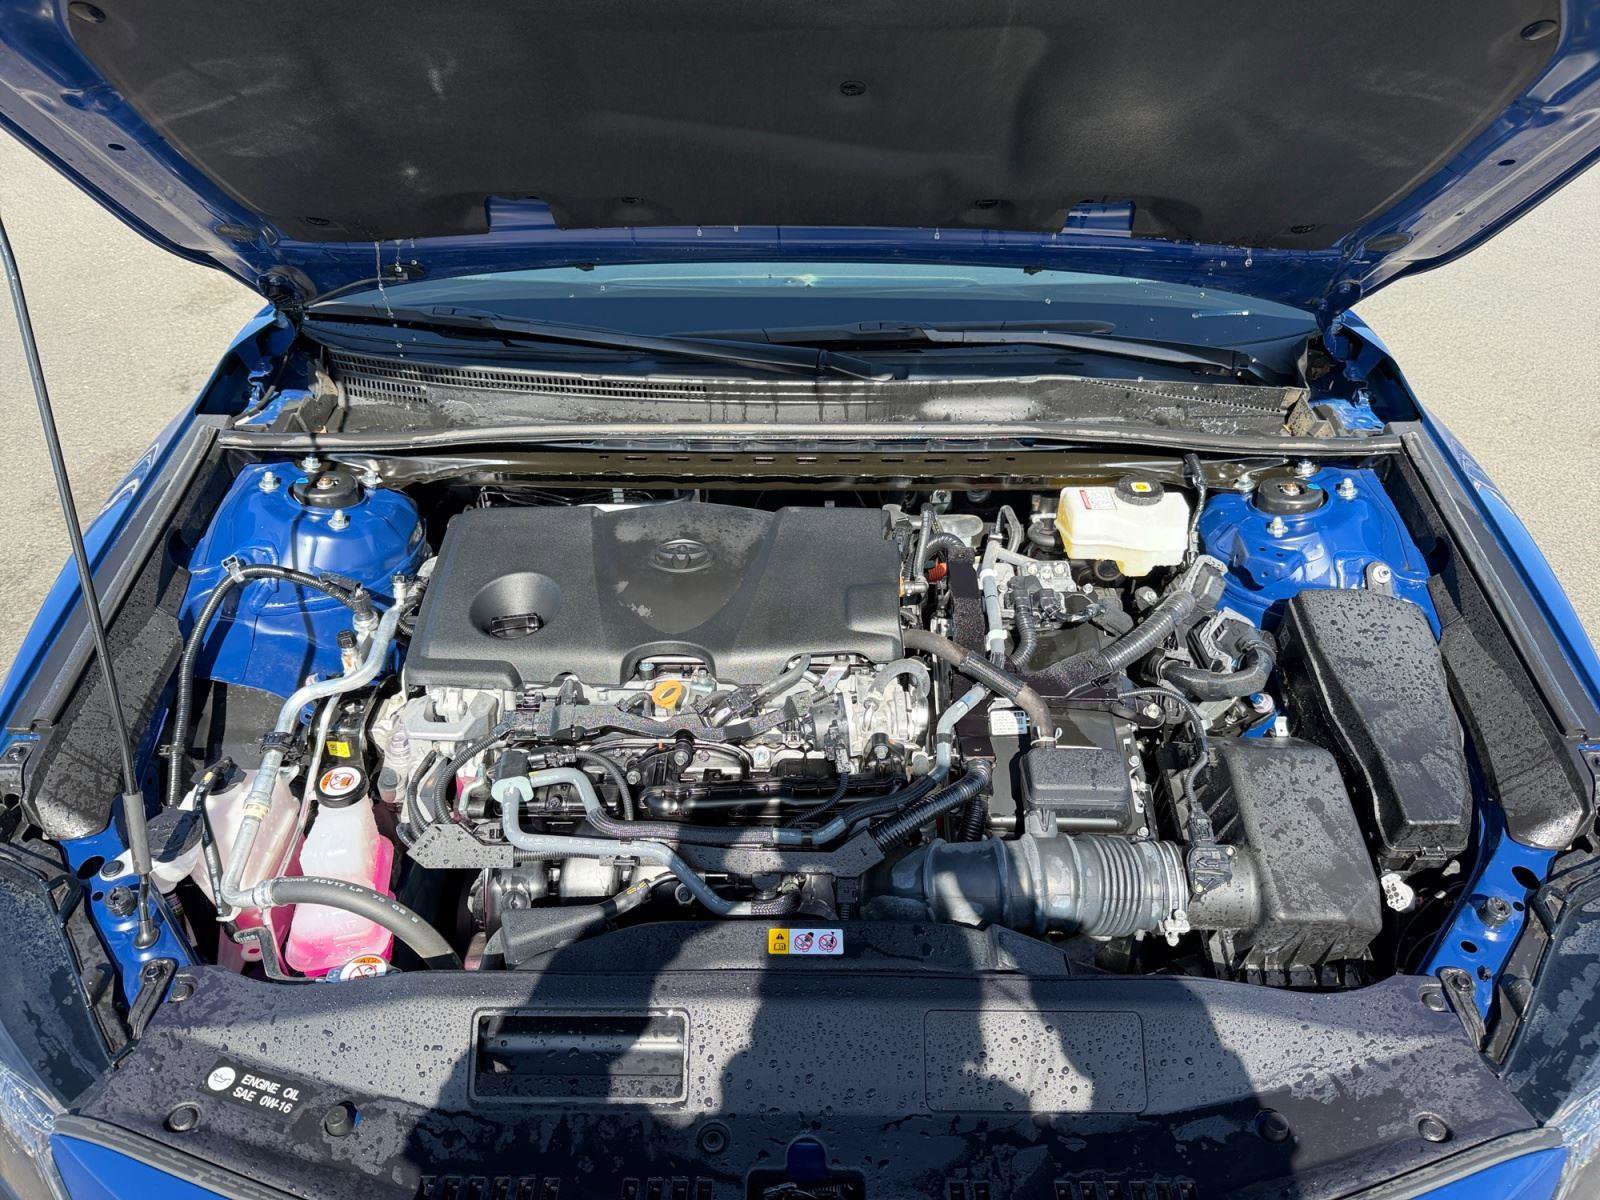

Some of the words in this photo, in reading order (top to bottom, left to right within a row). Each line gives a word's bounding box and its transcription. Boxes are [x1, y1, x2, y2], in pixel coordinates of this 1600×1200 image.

[232, 1086, 257, 1102] SAE
[259, 1095, 293, 1114] 0W-16
[241, 1074, 281, 1094] ENGINE
[283, 1087, 300, 1101] OIL
